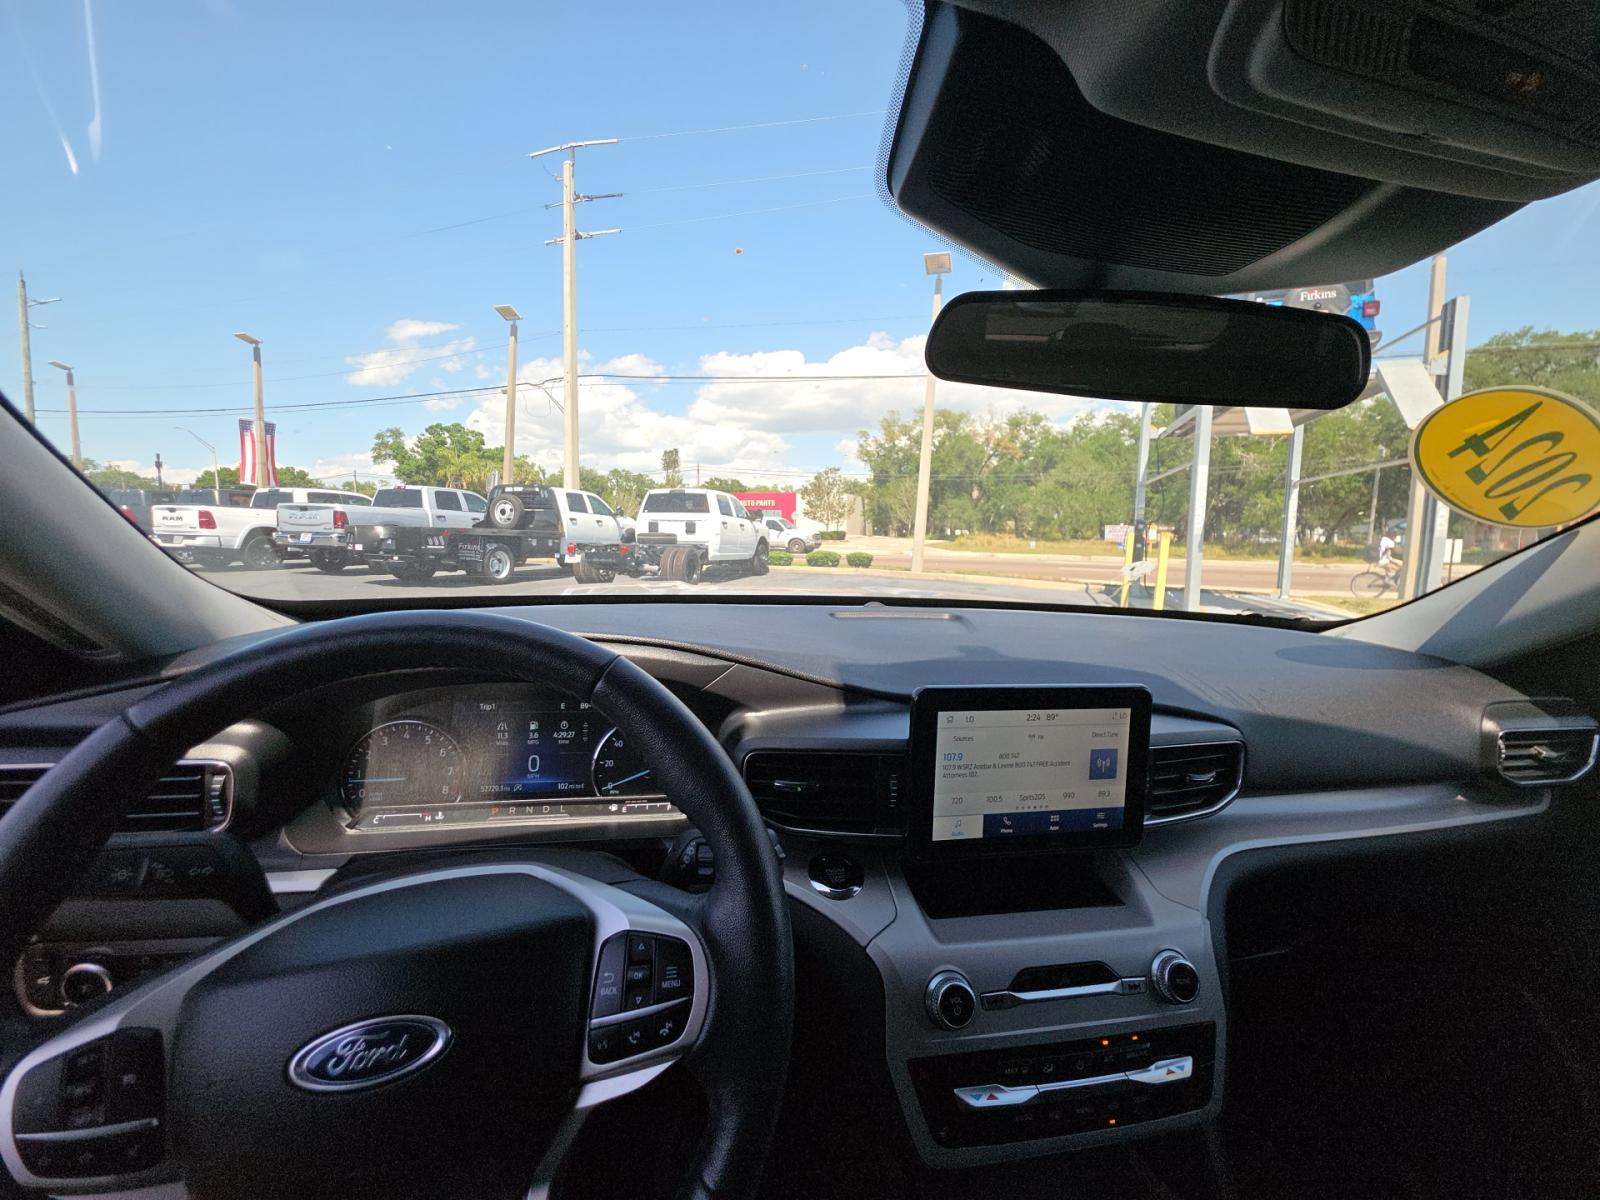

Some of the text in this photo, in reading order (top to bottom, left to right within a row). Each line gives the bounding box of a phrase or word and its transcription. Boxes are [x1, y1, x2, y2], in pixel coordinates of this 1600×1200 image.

[1300, 290, 1337, 302] Firkins
[755, 499, 776, 507] PARTS
[1026, 712, 1041, 722] 2:24
[942, 752, 963, 762] 107.9
[528, 754, 540, 772] 0
[661, 980, 681, 988] MENU
[327, 1032, 409, 1074] Ford
